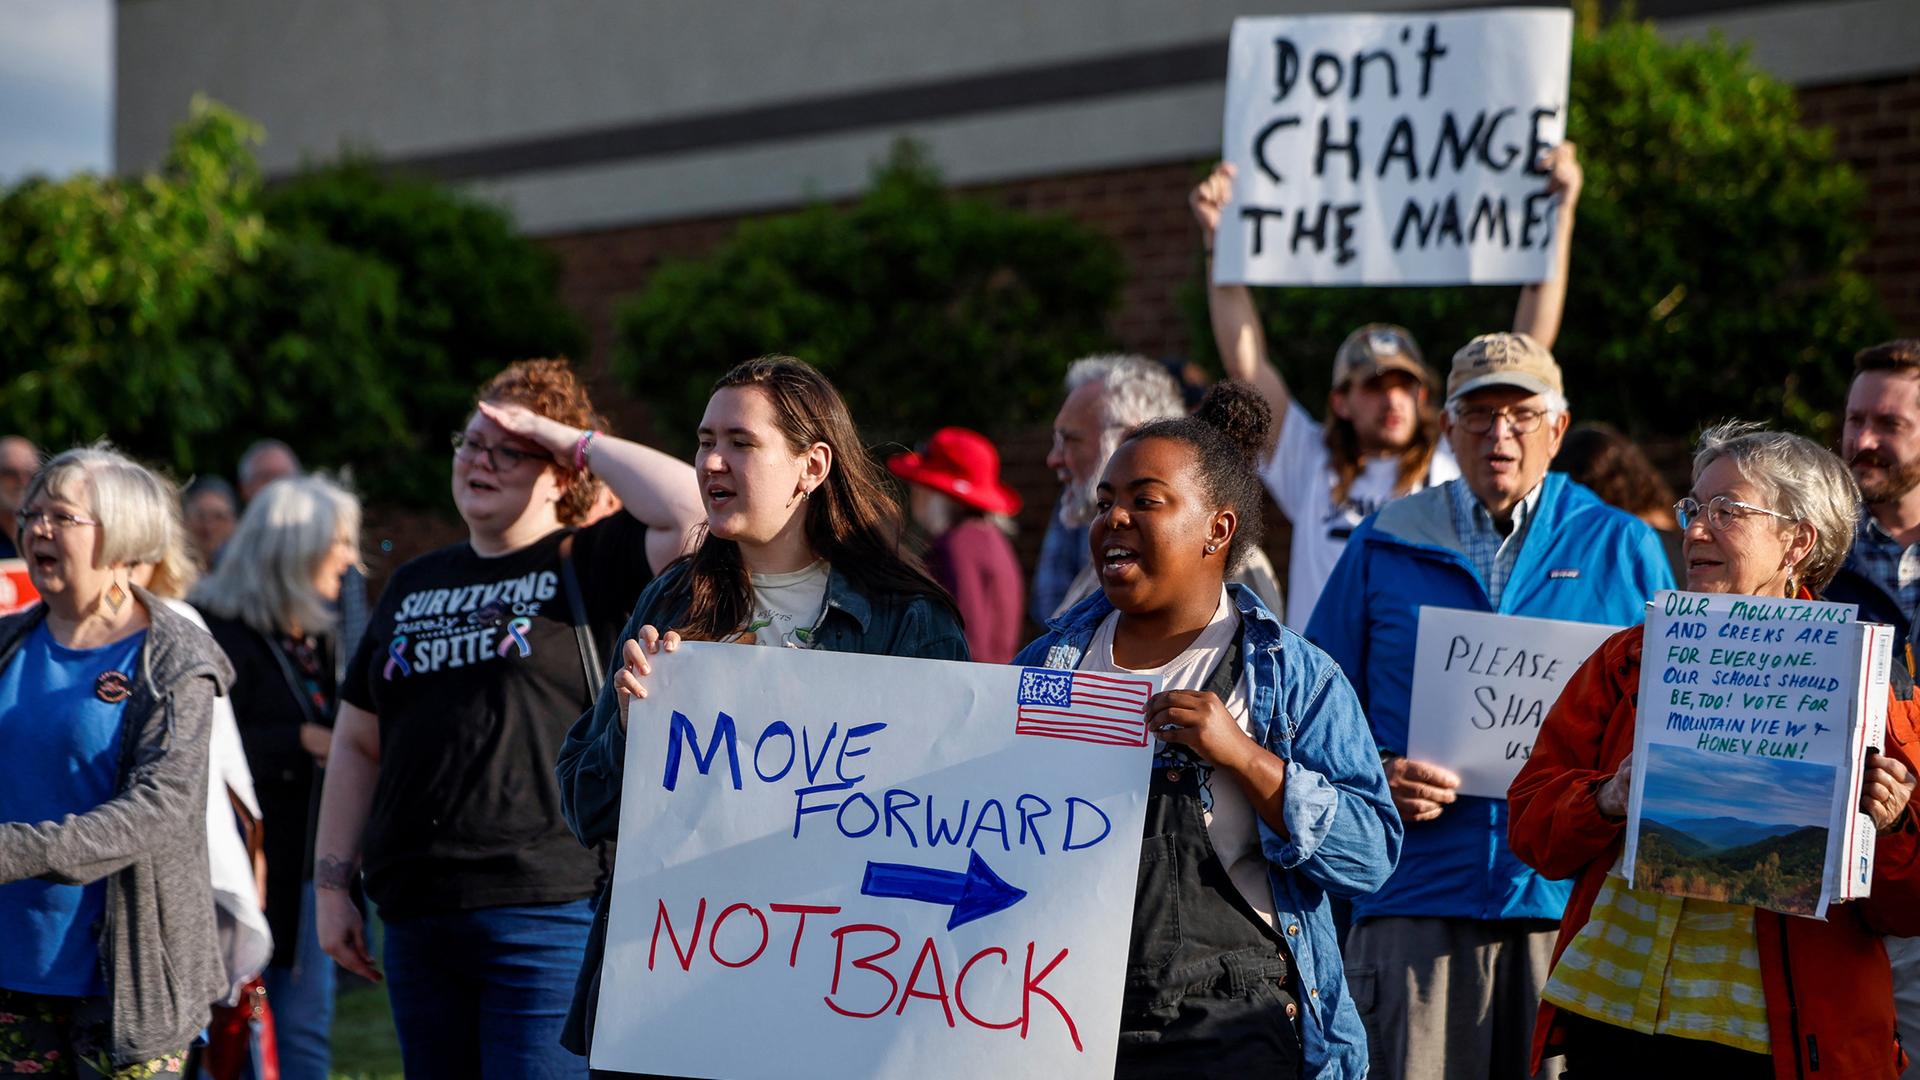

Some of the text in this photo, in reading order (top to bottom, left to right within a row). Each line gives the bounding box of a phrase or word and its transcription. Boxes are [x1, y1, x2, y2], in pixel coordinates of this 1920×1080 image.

[1273, 23, 1447, 102] Don't
[1253, 106, 1557, 184] CHANGE
[1239, 202, 1362, 267] THE
[394, 570, 558, 621] SURVIVING
[1665, 592, 1852, 624] OUR MOUNTAINS
[413, 627, 497, 673] SPITE
[1665, 621, 1838, 645] AND CREEKS ARE
[1667, 645, 1701, 664] FOR
[1444, 635, 1563, 681] PLEASE
[1663, 666, 1839, 692] OUR SCHOOLS SHOULD
[1471, 686, 1543, 730] SHA
[1666, 712, 1746, 732] MOUNTAIN
[1750, 718, 1807, 737] VIEW
[1744, 692, 1788, 710] VOTE
[1797, 694, 1829, 712] FOR
[663, 709, 888, 792] MOVE
[1697, 732, 1808, 759] HONEY RUN!
[793, 783, 1112, 856] FORWARD
[648, 897, 1083, 1053] NOT BACK
